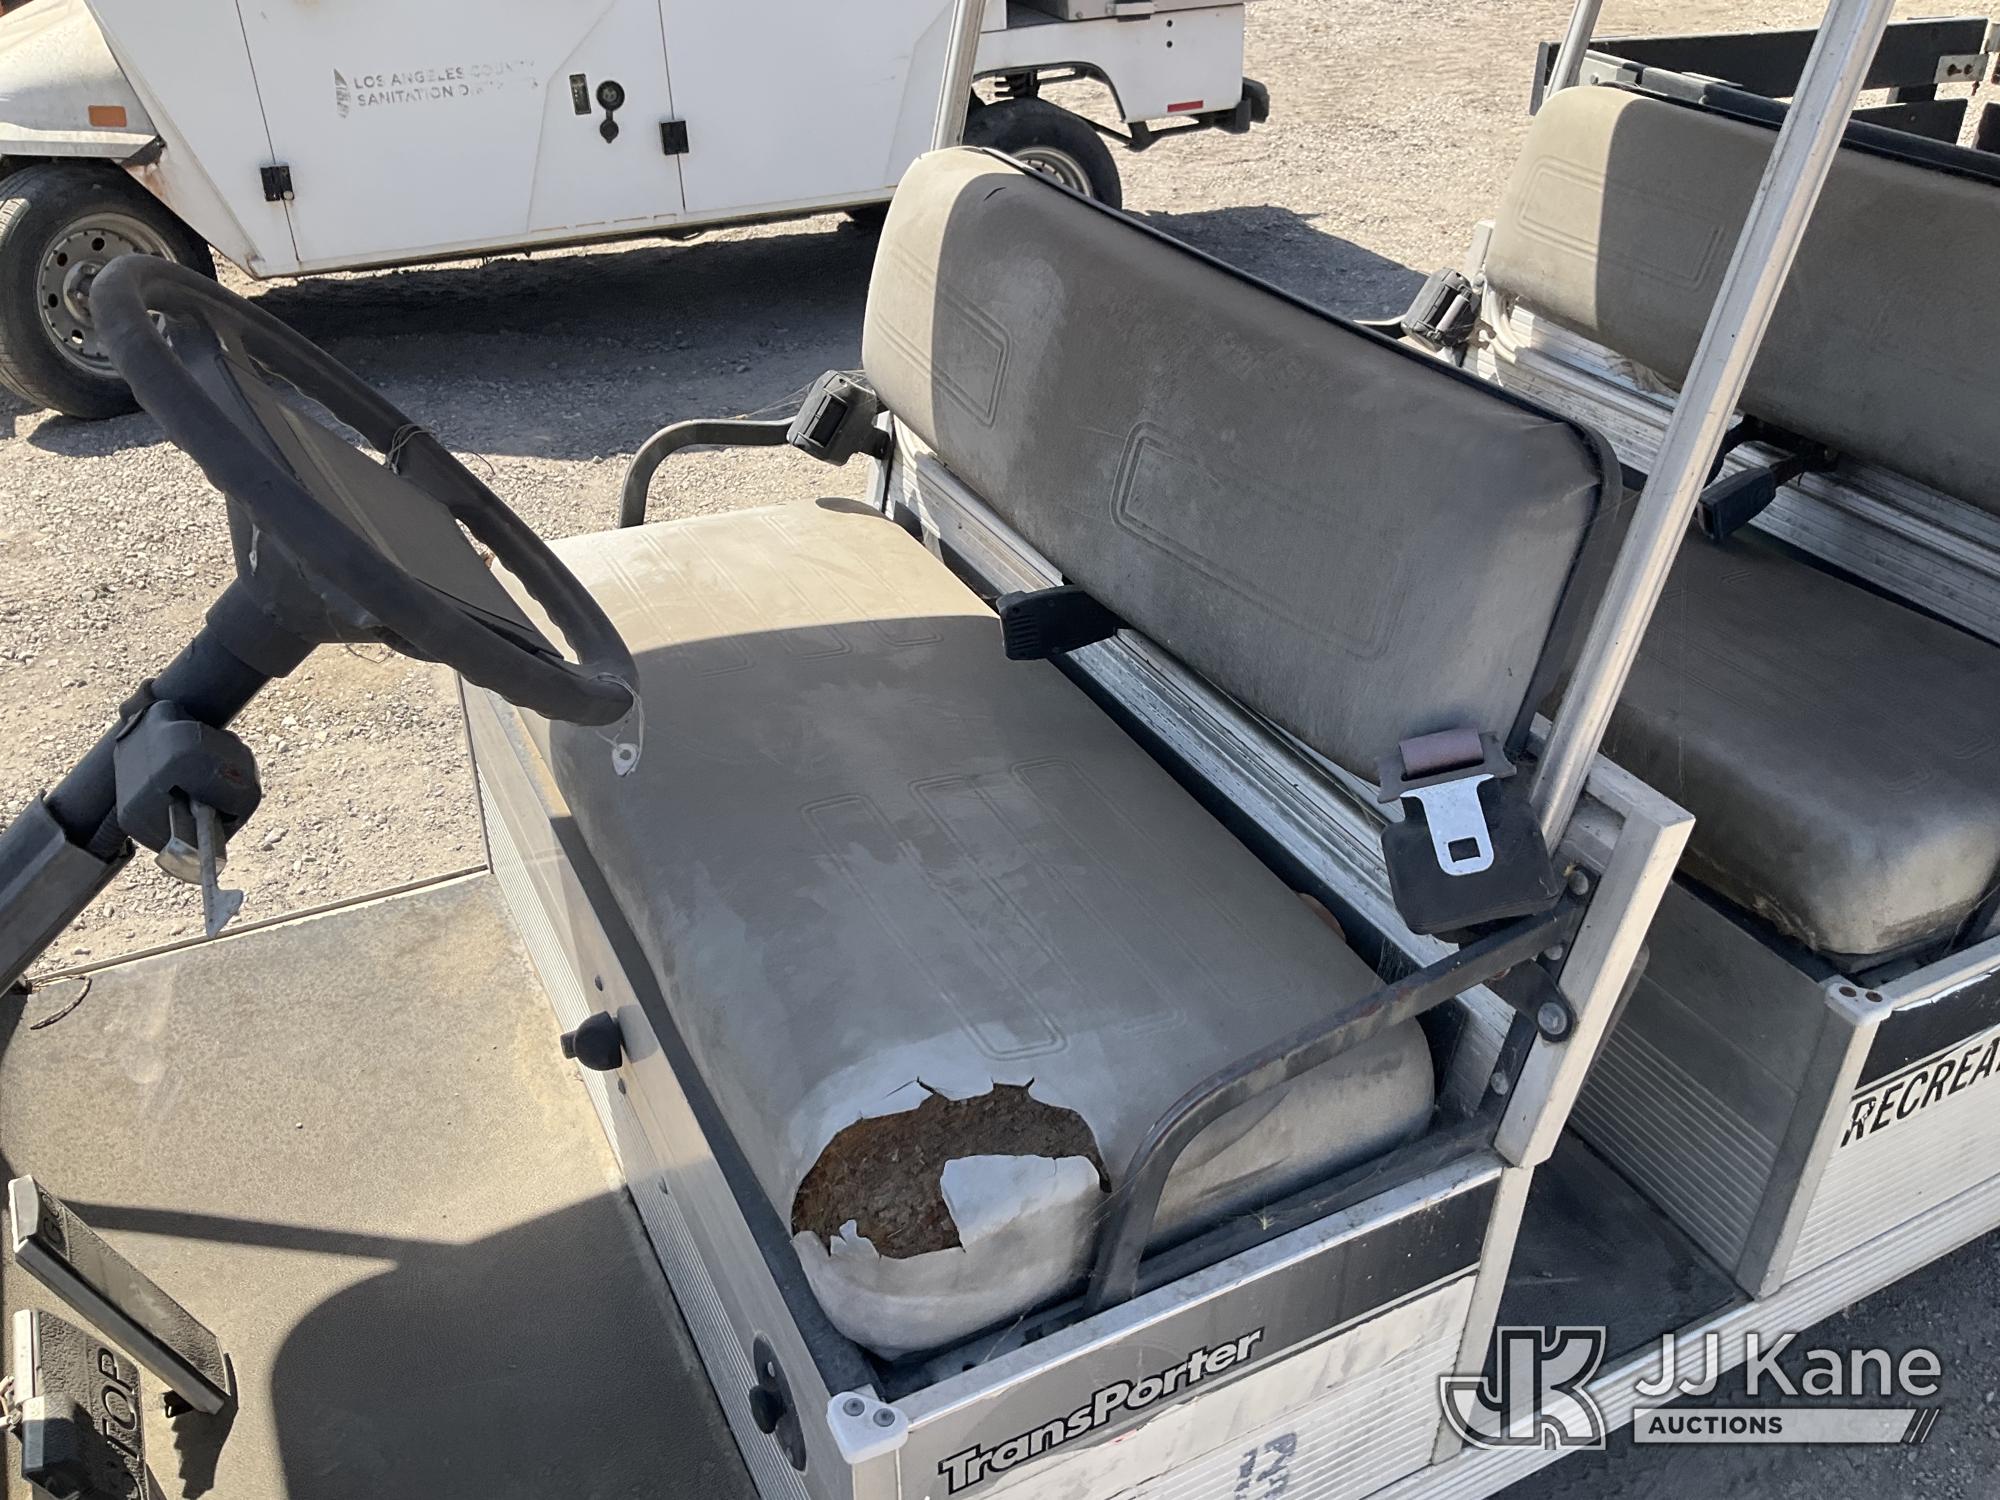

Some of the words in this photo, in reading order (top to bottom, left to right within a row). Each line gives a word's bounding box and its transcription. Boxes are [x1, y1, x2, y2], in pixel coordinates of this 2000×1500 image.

[353, 74, 385, 90] LOS
[356, 84, 454, 108] SANITATION
[1840, 1036, 2000, 1148] RECREA
[938, 1327, 1265, 1496] TransPorter
